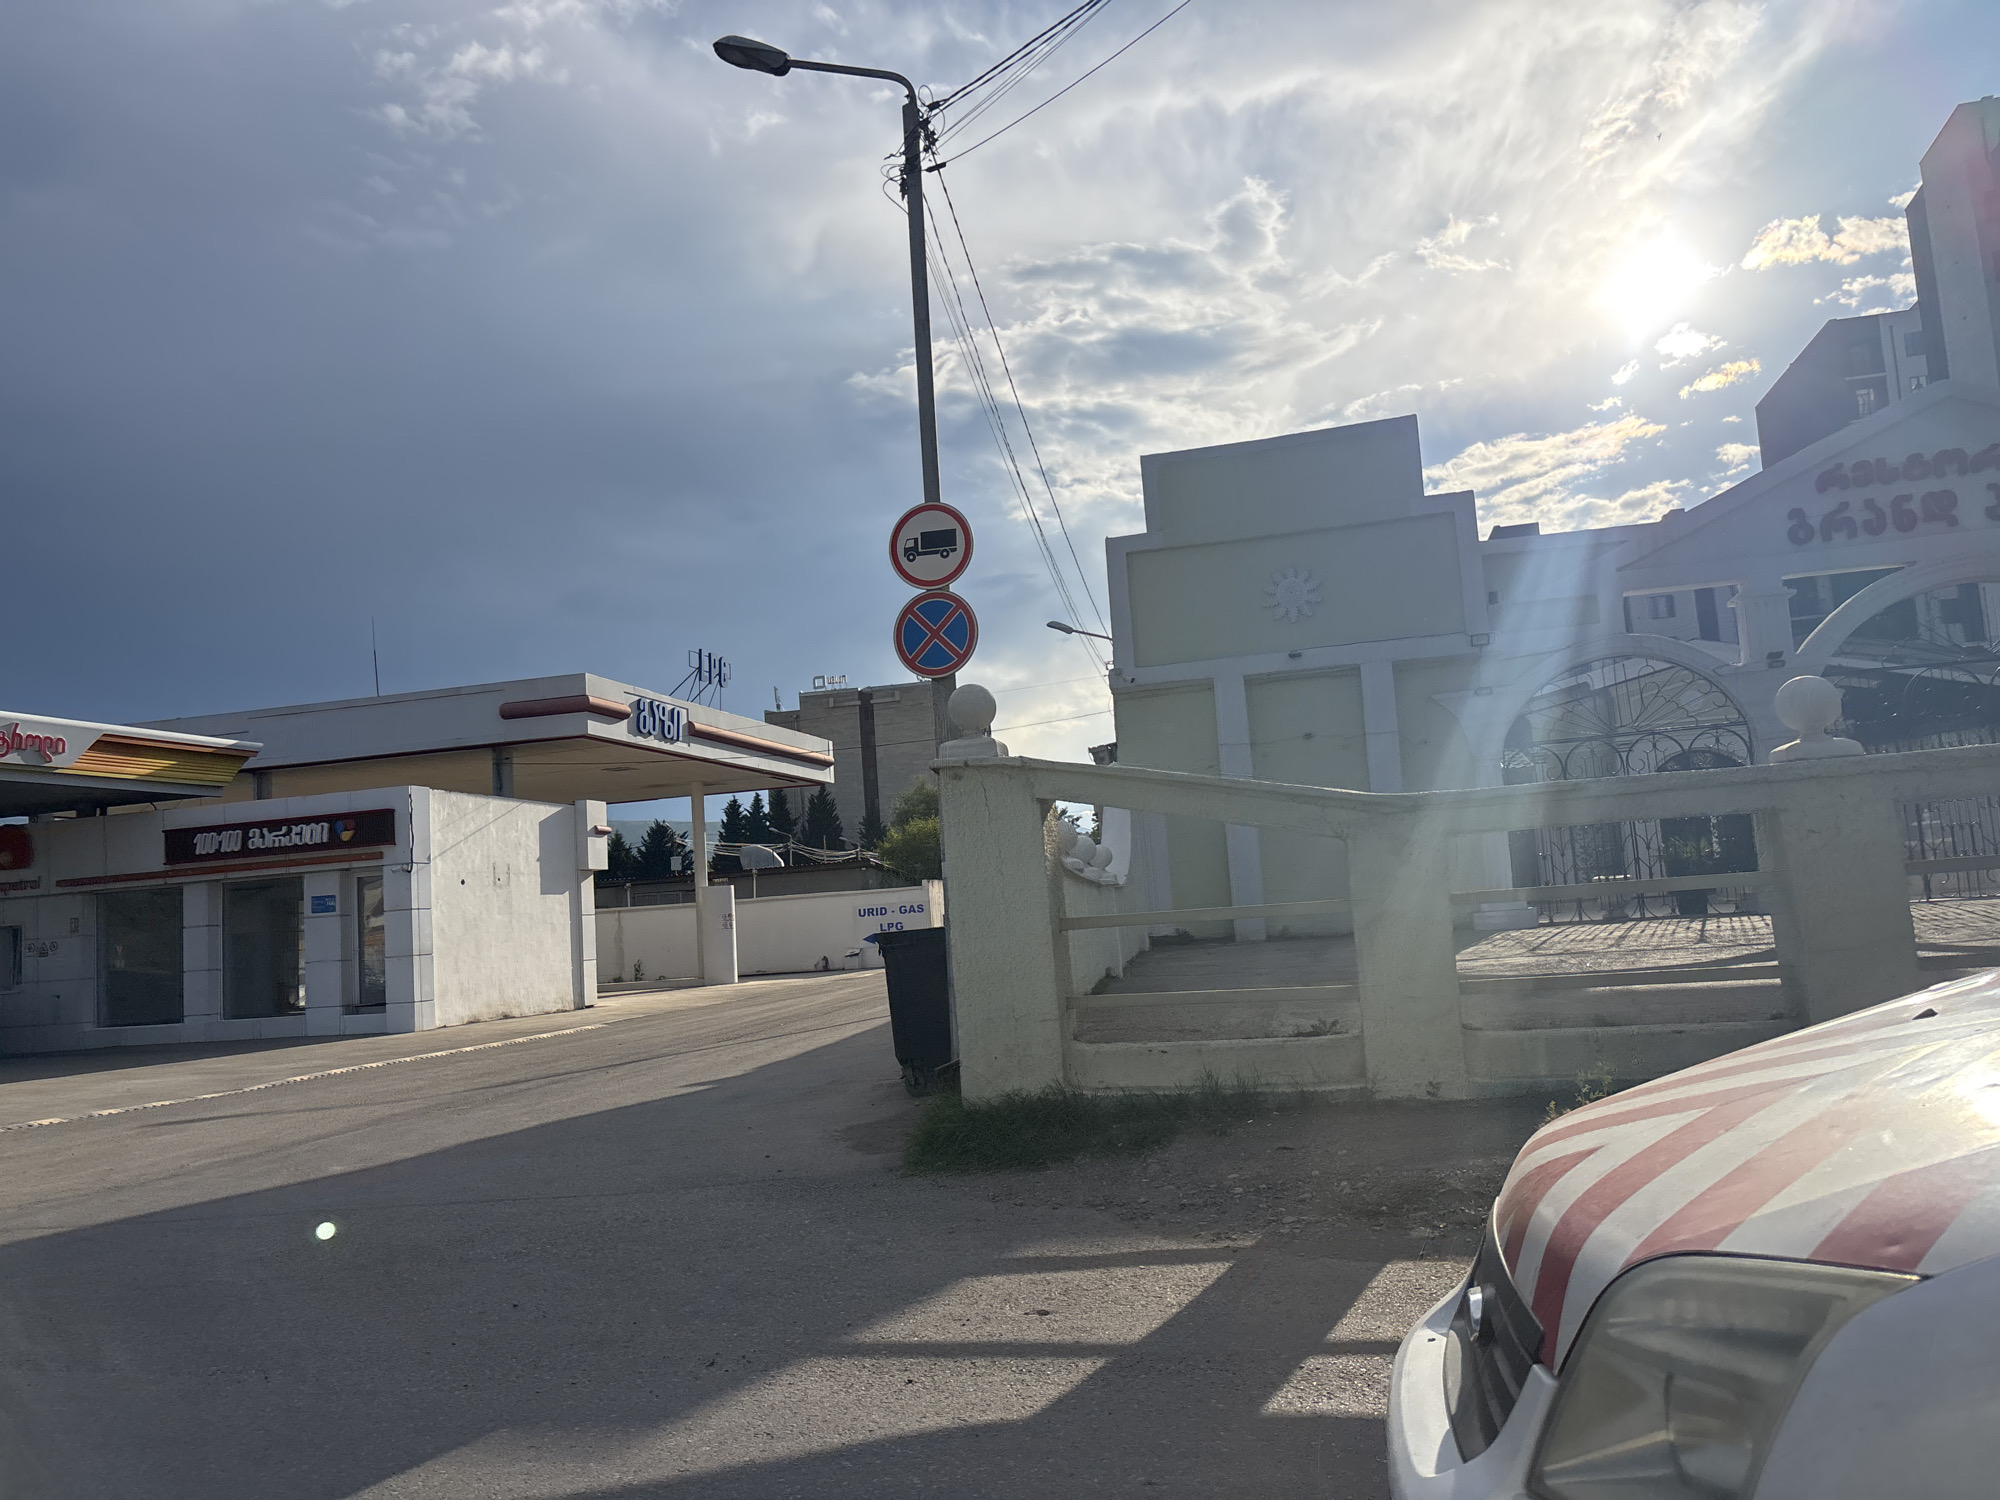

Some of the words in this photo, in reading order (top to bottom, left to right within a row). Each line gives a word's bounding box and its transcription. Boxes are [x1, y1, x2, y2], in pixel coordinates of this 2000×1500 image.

[1787, 489, 1959, 545] გრანდ
[698, 648, 729, 688] LPG
[636, 697, 682, 742] გაზი
[248, 822, 330, 849] მარკეტი
[858, 907, 888, 918] URID
[898, 903, 925, 915] GAS
[879, 921, 904, 932] LPG
